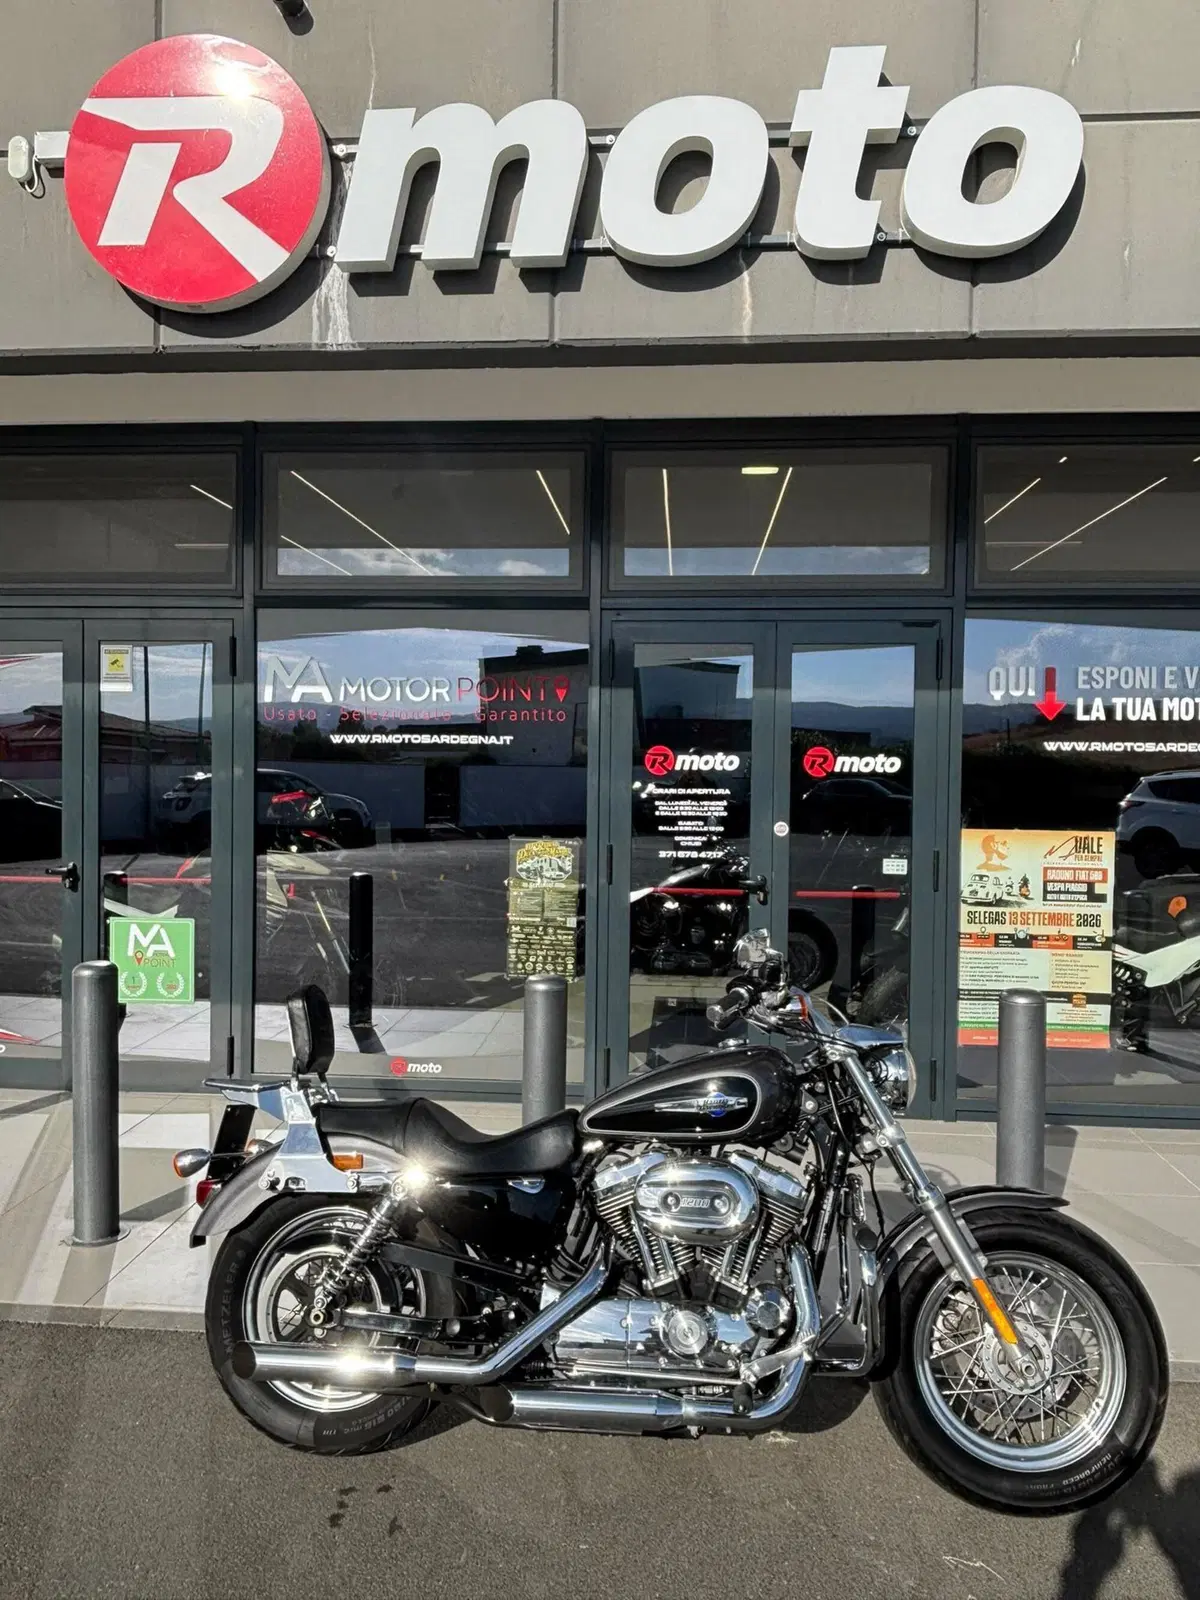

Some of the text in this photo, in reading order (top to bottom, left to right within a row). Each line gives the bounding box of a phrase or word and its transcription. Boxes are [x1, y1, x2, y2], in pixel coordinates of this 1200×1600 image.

[335, 45, 1085, 273] moto
[989, 666, 1035, 700] QUI
[1078, 666, 1156, 689] ESPONI
[1165, 666, 1178, 689] E
[340, 677, 451, 702] MOTOR
[457, 676, 550, 702] POINT
[264, 706, 567, 722] Usato Selezionato Garantito
[1076, 697, 1106, 721] LA
[1112, 697, 1156, 721] TUA
[330, 734, 514, 745] WWW.RMOTOSARDEGNA.IT
[1043, 741, 1200, 752] WWW.RMOTOSARDE
[674, 754, 740, 772] moto
[833, 753, 902, 773] moto
[967, 910, 1102, 928] SELEGAS 13 SETTEMBRE 2026
[144, 958, 176, 968] POINT
[407, 1062, 442, 1073] moto
